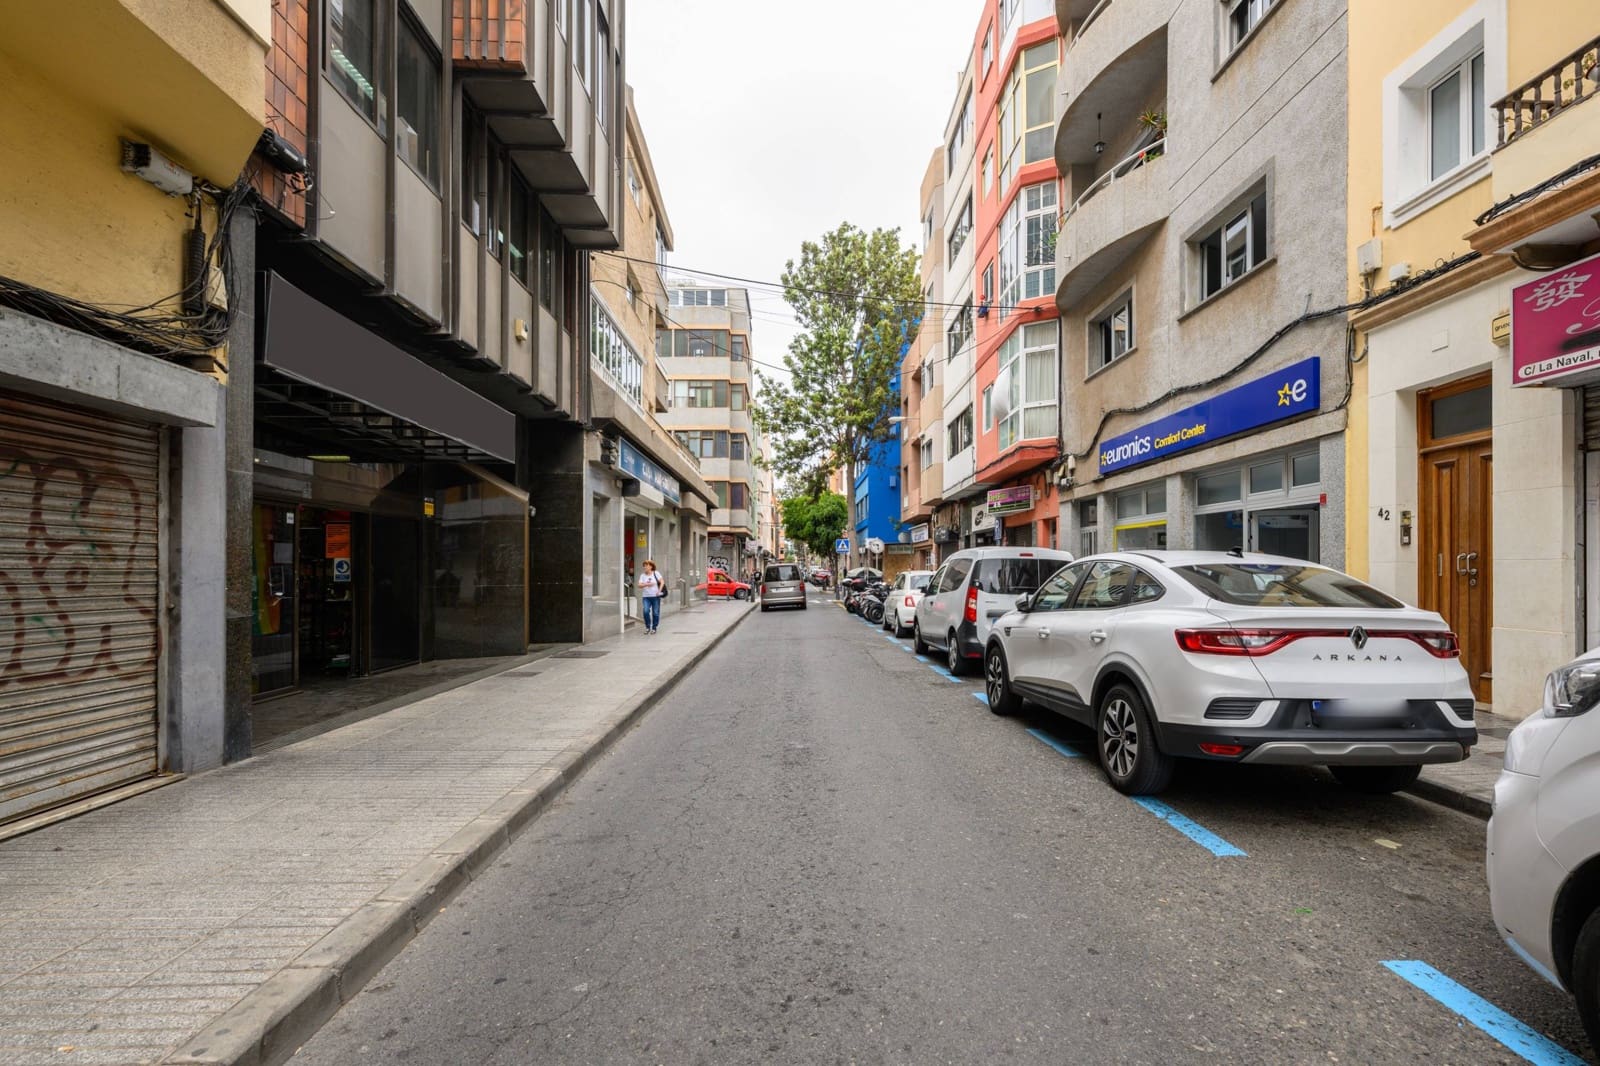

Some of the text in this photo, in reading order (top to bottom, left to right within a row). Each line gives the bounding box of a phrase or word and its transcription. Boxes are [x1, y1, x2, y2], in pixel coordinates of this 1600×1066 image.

[1524, 364, 1536, 376] C/
[1539, 362, 1553, 373] La
[1556, 351, 1594, 368] Naval,
[1106, 424, 1207, 465] euronics Comfort Center
[1378, 507, 1390, 521] 42
